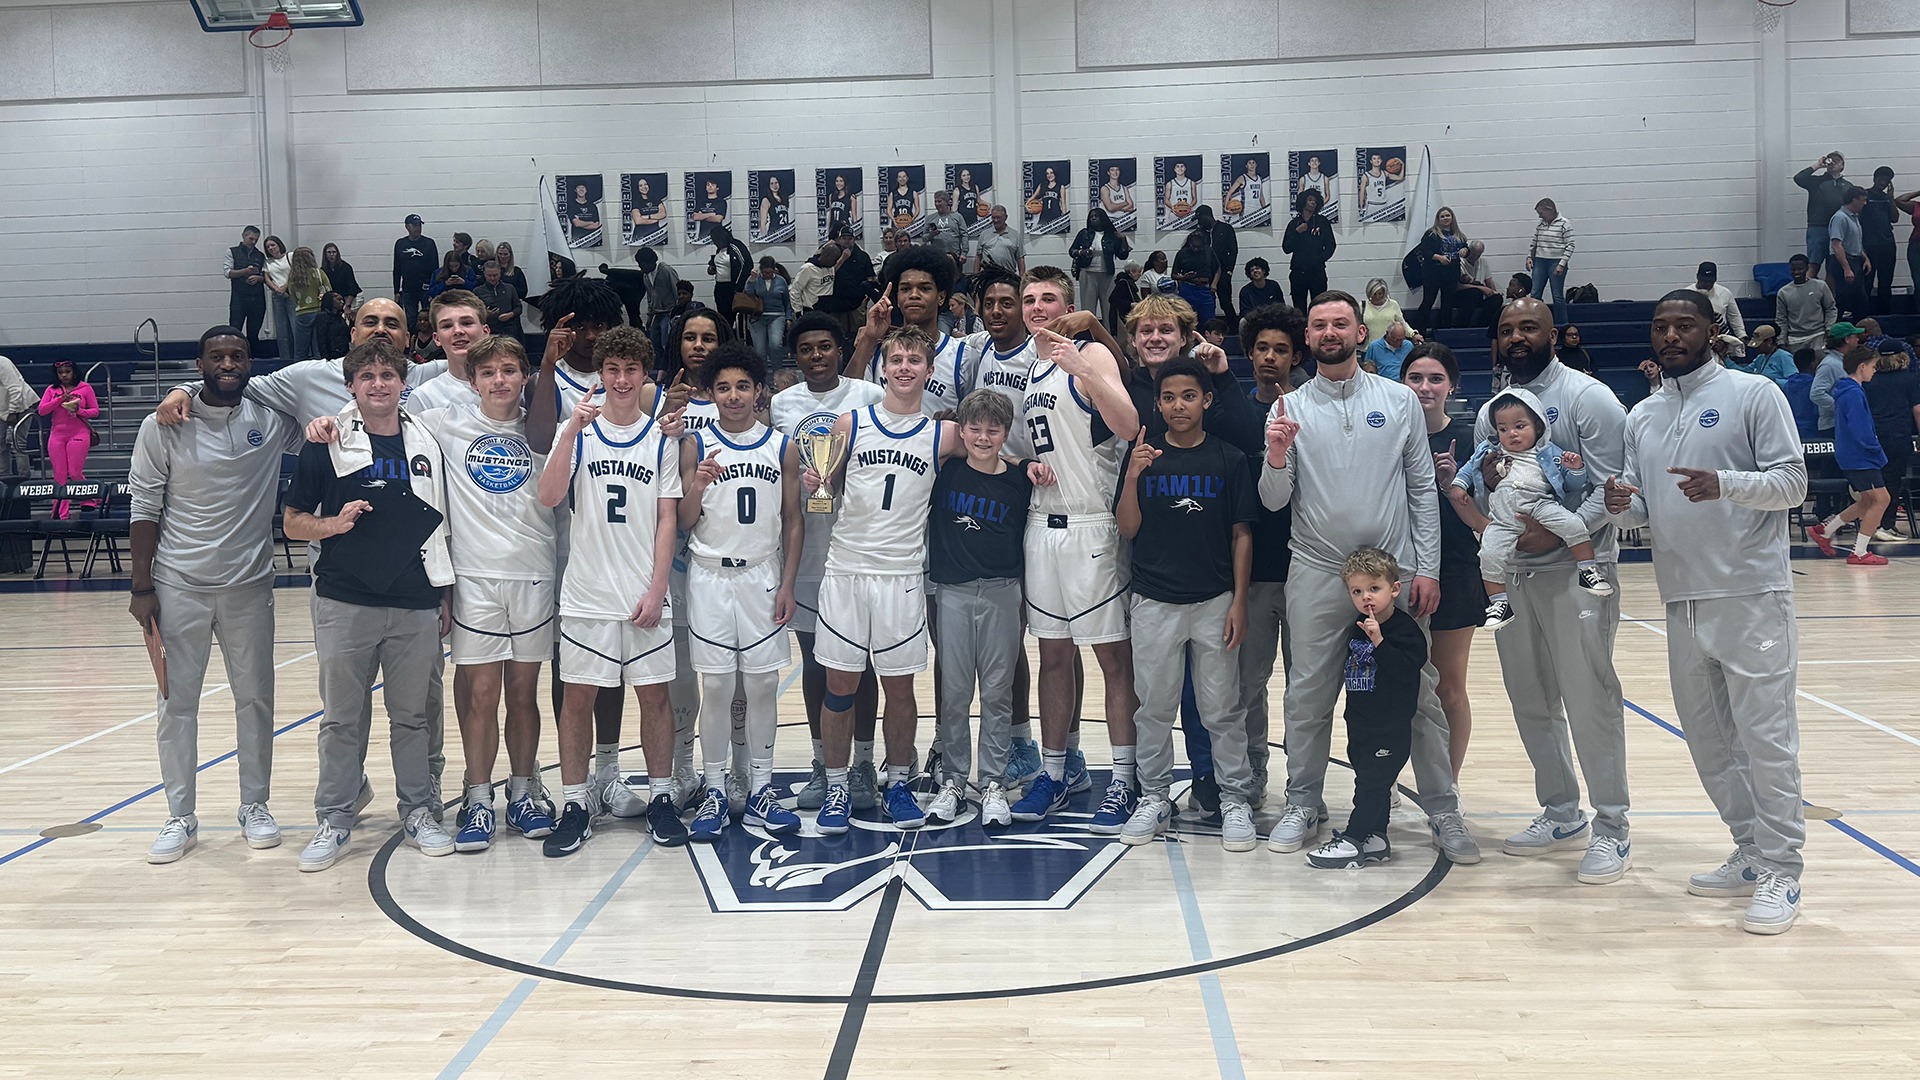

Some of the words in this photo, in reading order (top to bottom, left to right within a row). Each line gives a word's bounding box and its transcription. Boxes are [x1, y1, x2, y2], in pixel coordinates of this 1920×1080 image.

[685, 172, 696, 232] WEBER
[748, 171, 759, 230] WEBER
[816, 168, 826, 227] WEBER
[1023, 162, 1033, 220] WEBR
[1089, 159, 1100, 208] WEBE
[1154, 157, 1166, 216] WEBER
[621, 174, 632, 233] WEBER
[983, 371, 1028, 392] MUSTANGS
[476, 438, 498, 452] MOUNT
[500, 438, 524, 456] VERNON
[1026, 414, 1054, 456] 23
[468, 454, 530, 467] MUSTANGS
[587, 460, 654, 485] MUSTANGS
[857, 449, 929, 476] MUSTANGS
[20, 484, 54, 496] WEBER
[66, 484, 99, 496] WEBER
[477, 475, 520, 489] BASKETBALL
[882, 474, 896, 511] 1
[1145, 474, 1226, 498] FAM1LY
[606, 484, 627, 524] 2
[736, 486, 756, 525] 0
[941, 488, 1011, 524] FAM1LY
